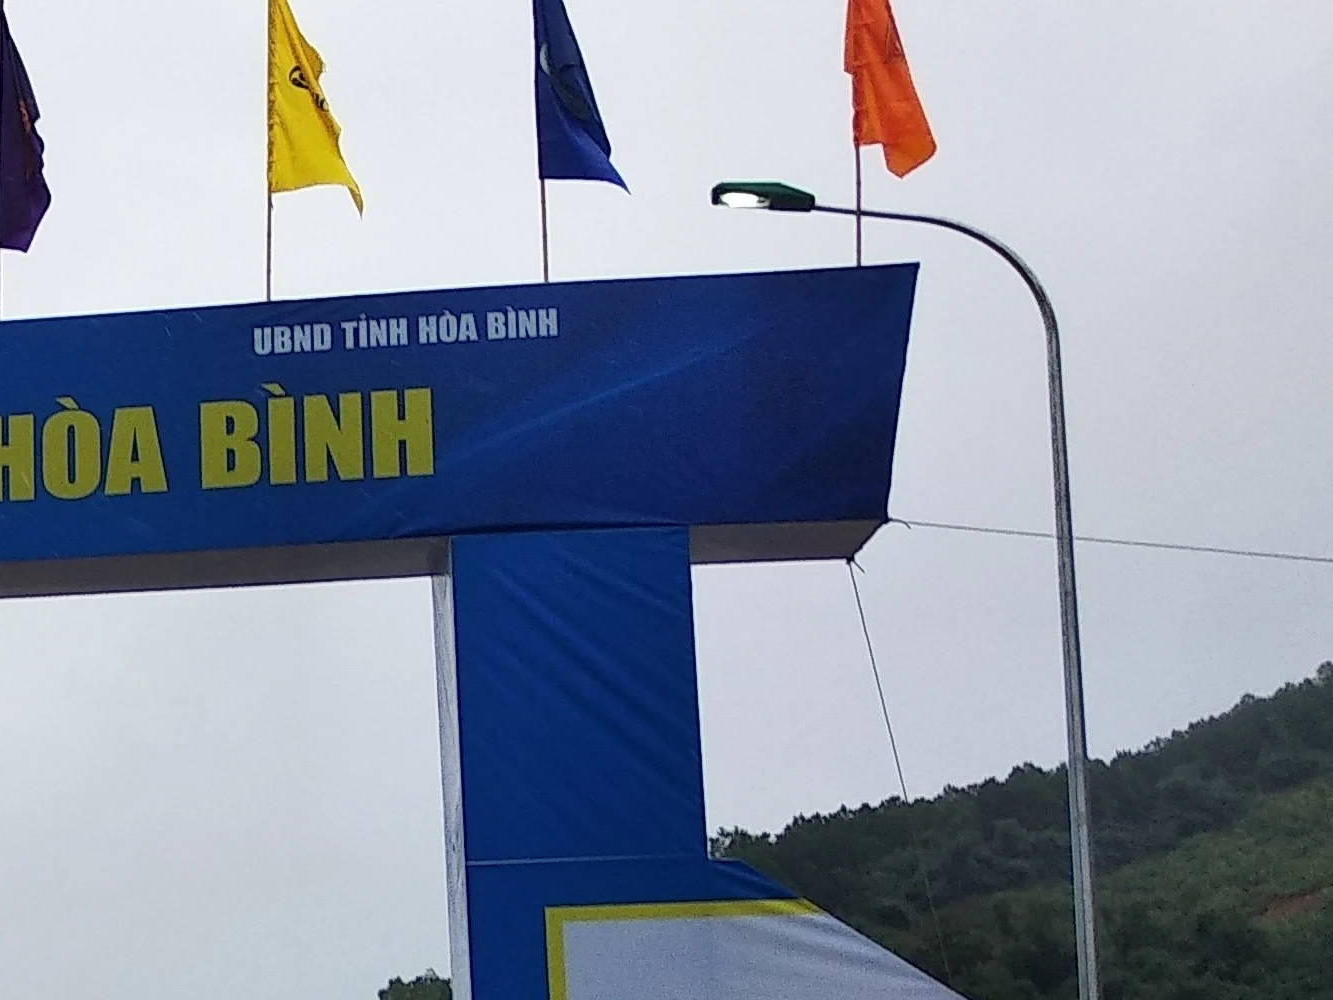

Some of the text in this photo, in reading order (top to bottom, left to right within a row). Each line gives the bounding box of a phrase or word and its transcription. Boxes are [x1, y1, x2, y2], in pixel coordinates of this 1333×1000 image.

[253, 305, 559, 356] UBND TỈNH HÒA BÌNH
[199, 382, 437, 492] BÌNH
